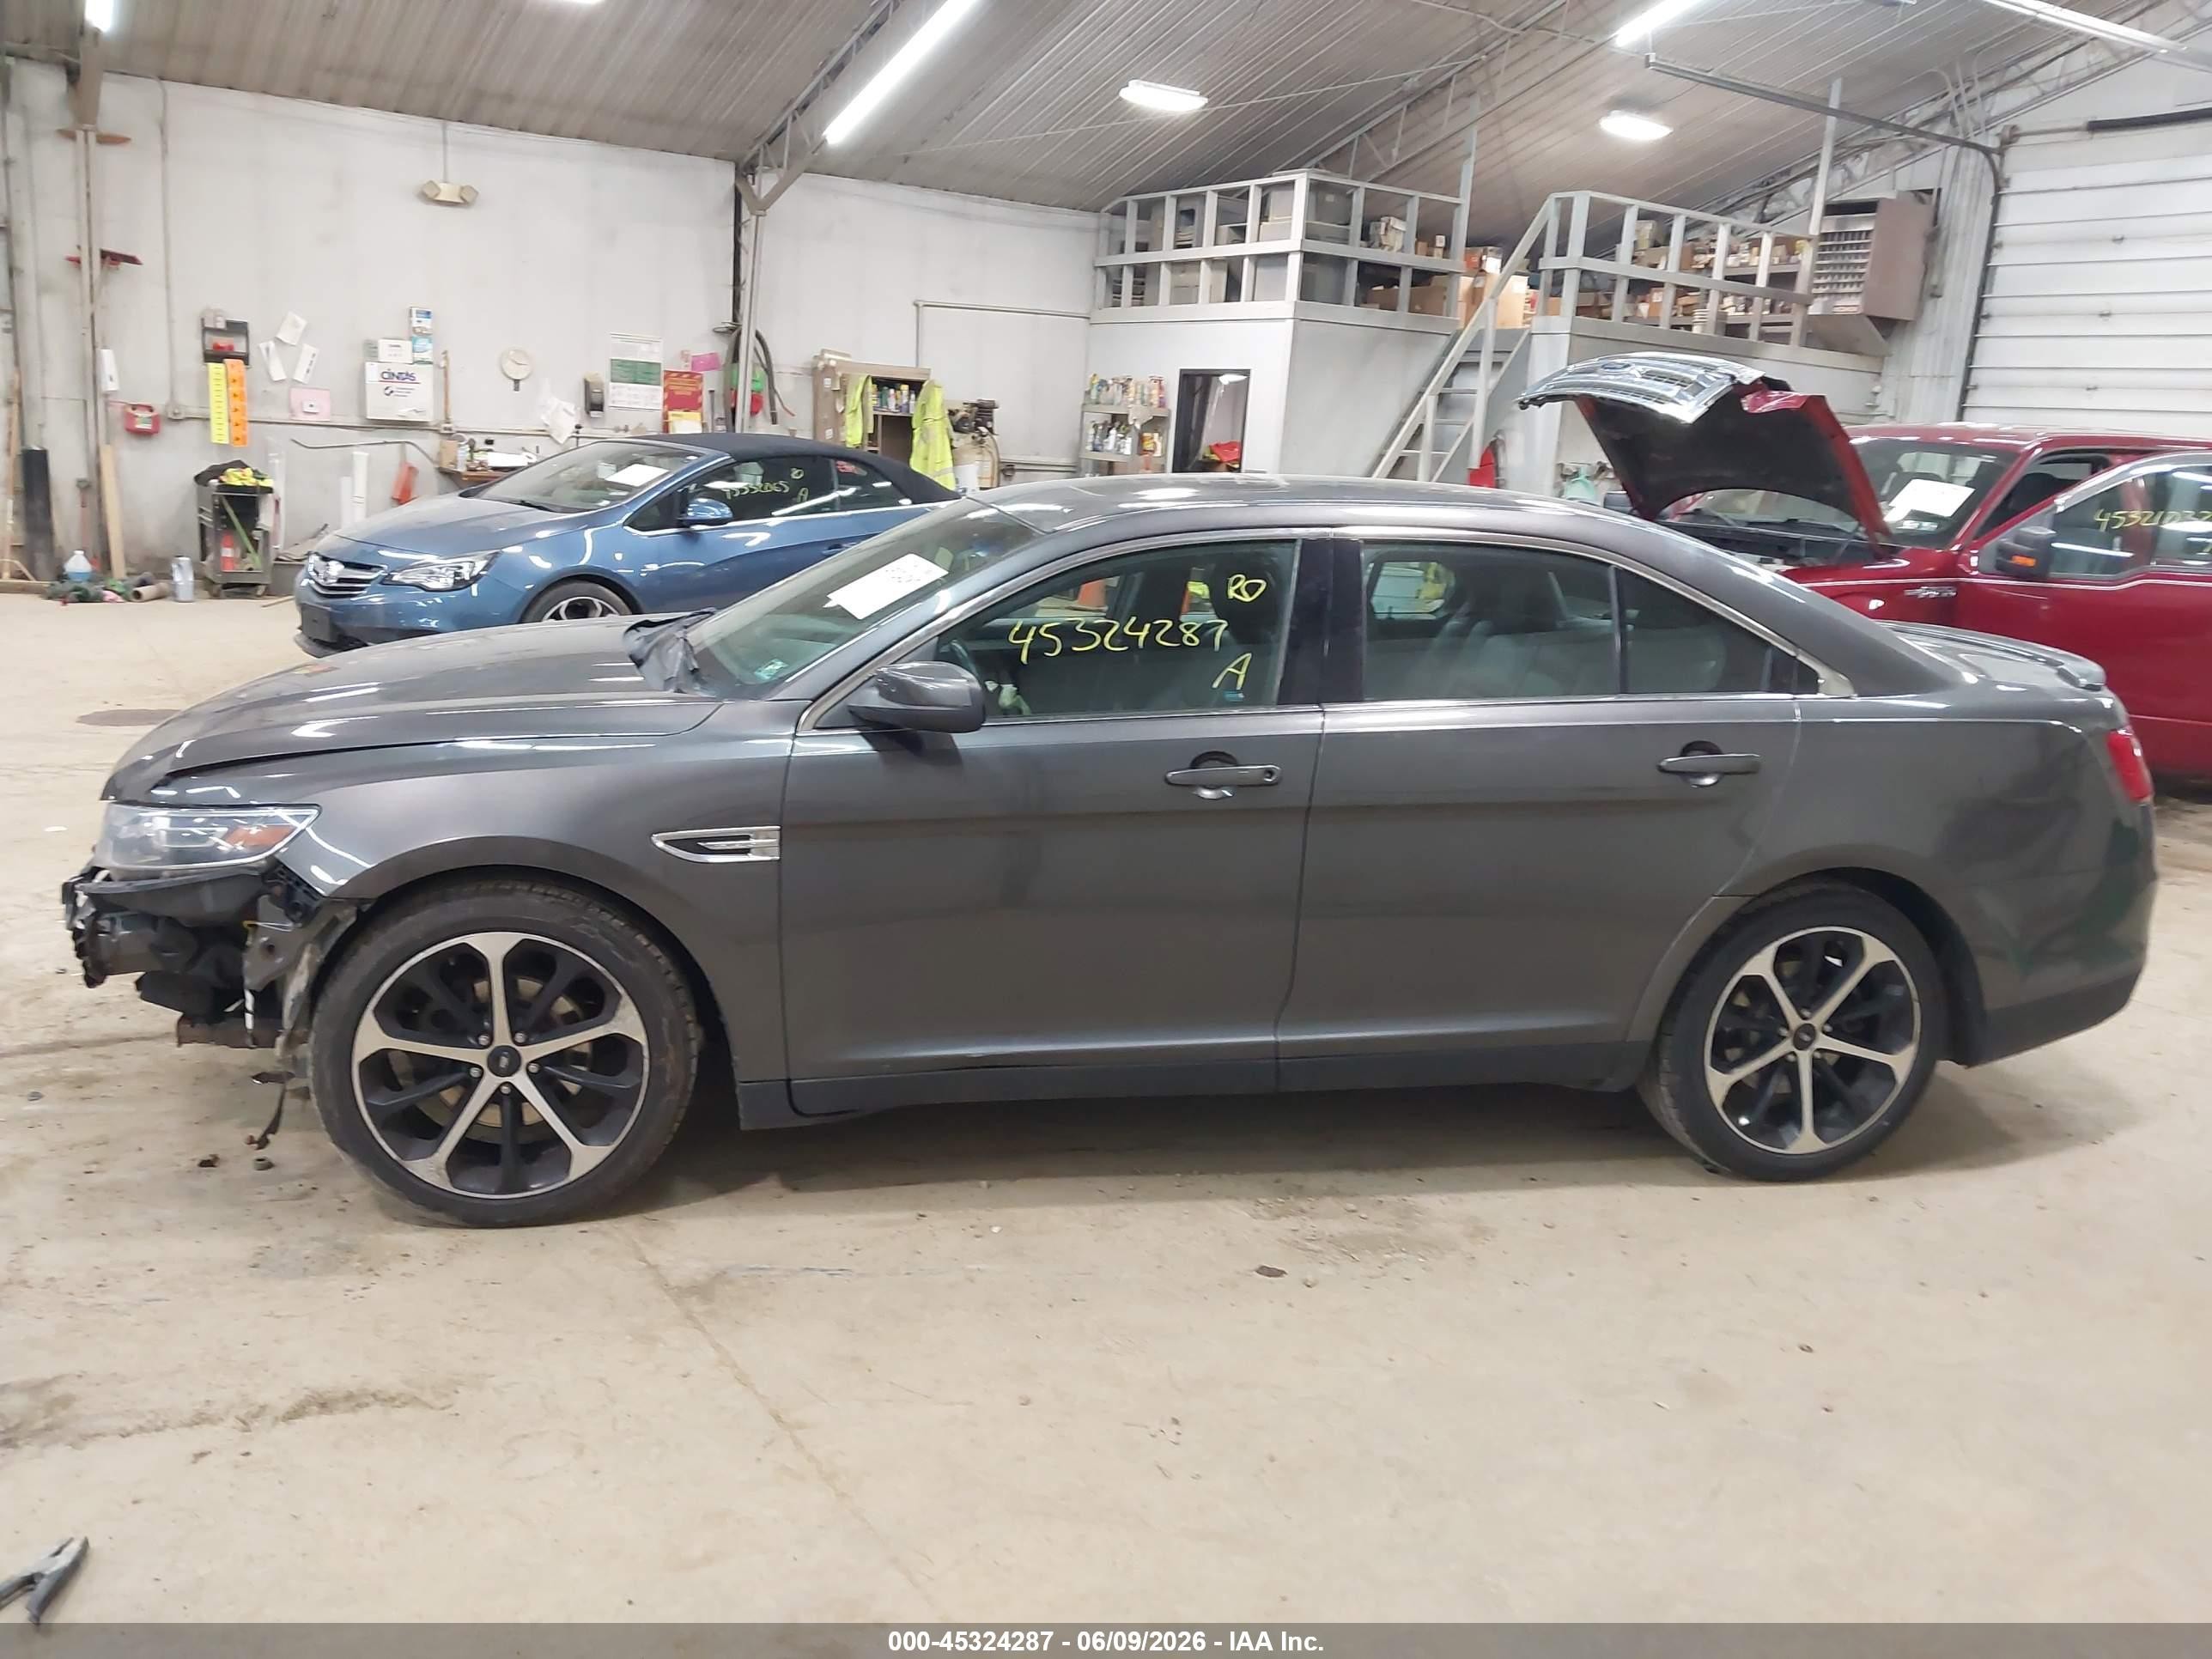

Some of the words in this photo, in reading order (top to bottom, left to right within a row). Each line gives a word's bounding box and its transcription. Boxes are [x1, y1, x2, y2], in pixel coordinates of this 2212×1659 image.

[1227, 574, 1267, 602] RO
[1007, 616, 1229, 665] 45324287
[1211, 653, 1253, 690] A
